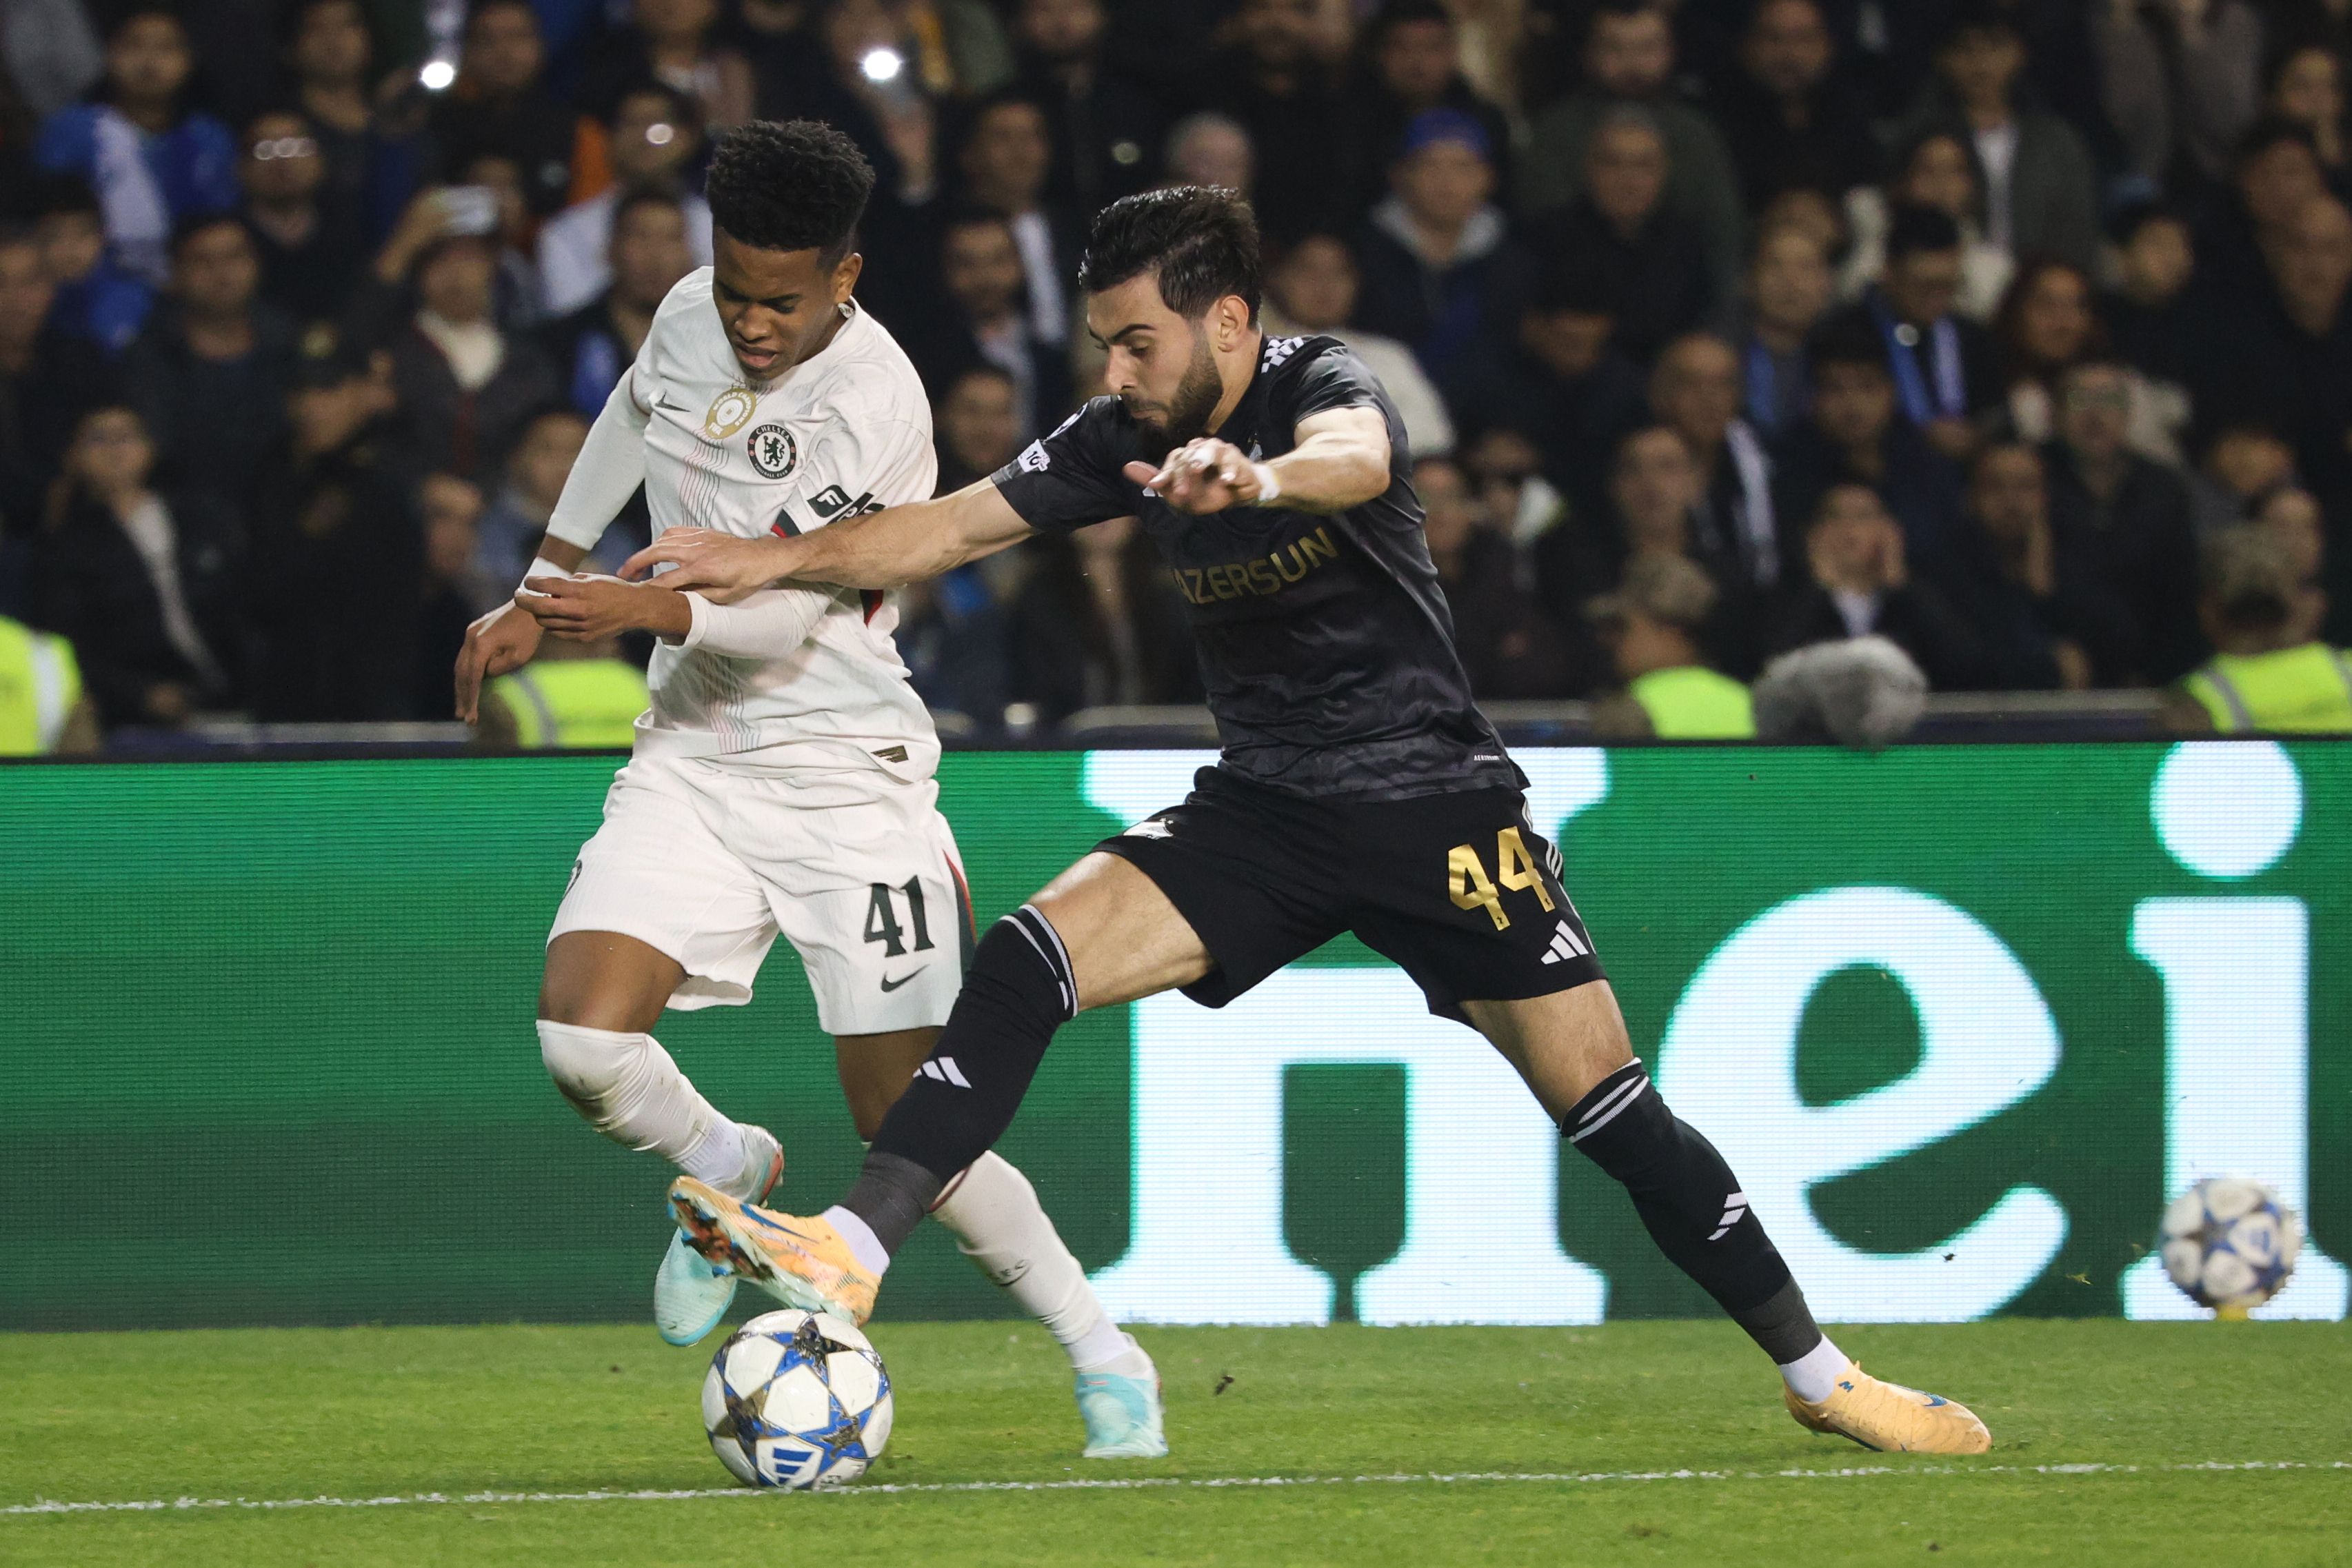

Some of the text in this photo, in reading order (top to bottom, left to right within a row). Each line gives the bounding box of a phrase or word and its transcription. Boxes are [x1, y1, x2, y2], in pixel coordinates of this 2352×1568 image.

[756, 425, 790, 441] CHELSEA
[863, 874, 936, 958] 41
[1448, 826, 1555, 932] 44
